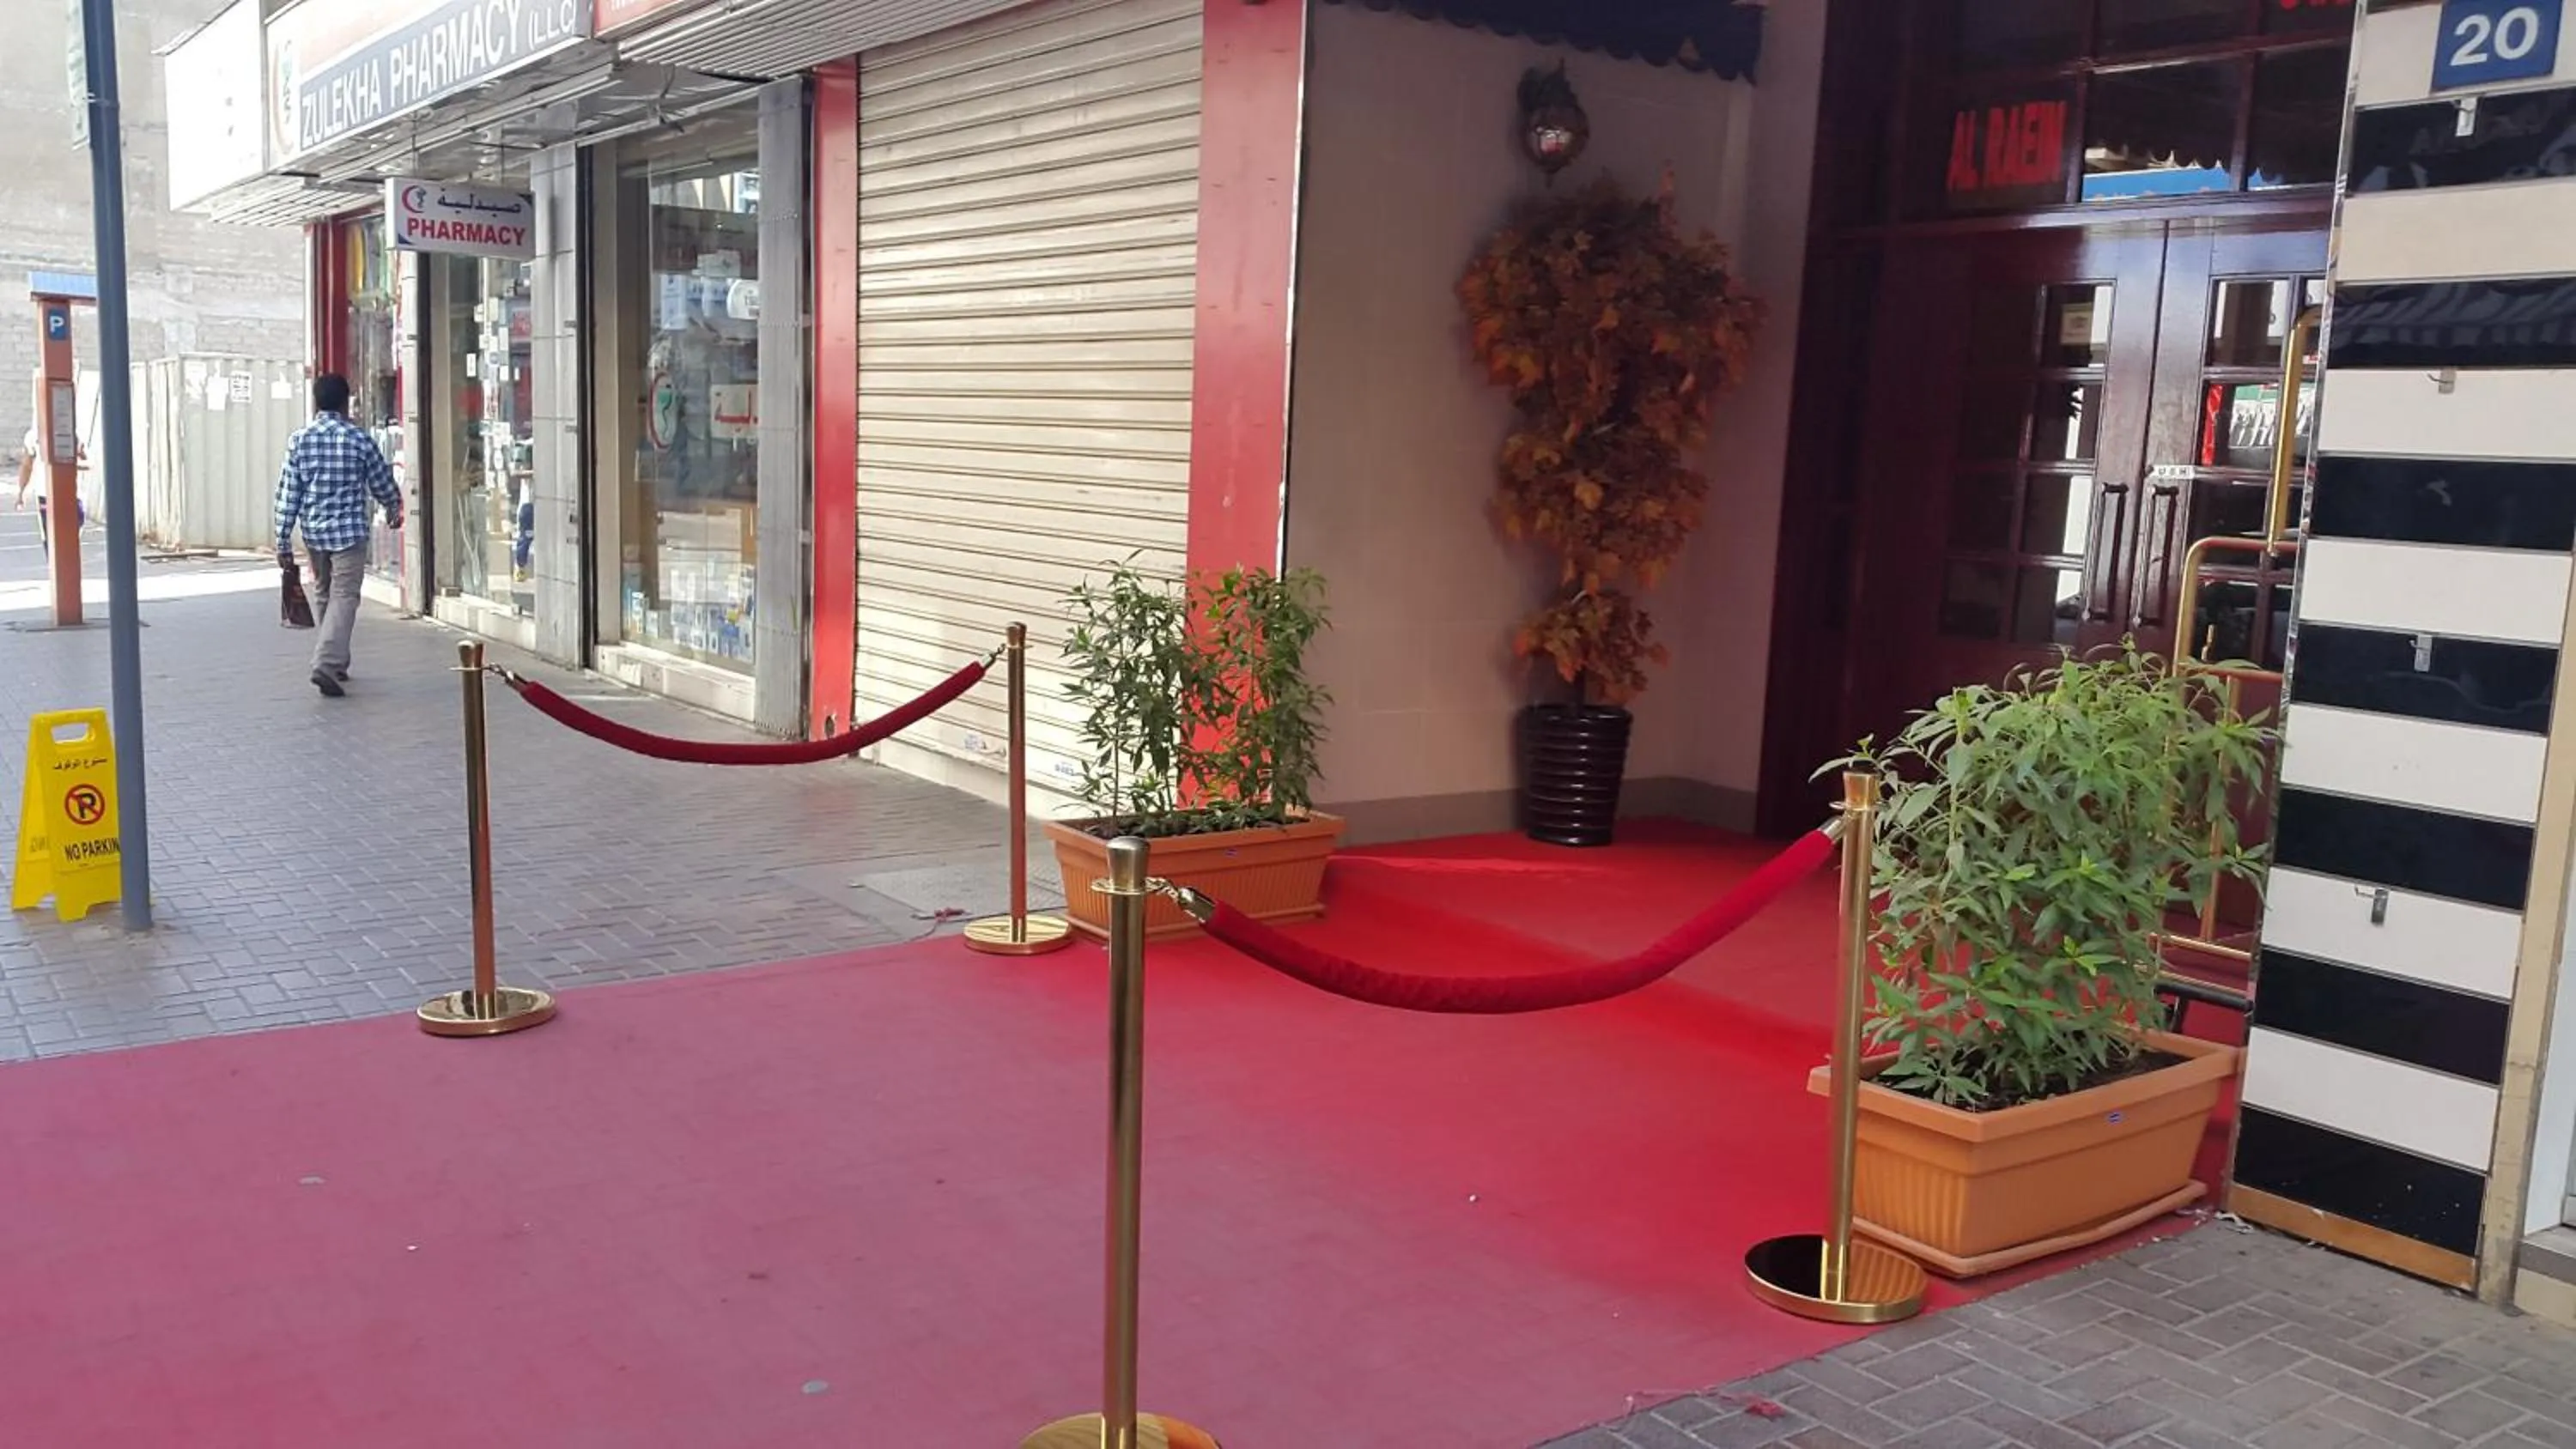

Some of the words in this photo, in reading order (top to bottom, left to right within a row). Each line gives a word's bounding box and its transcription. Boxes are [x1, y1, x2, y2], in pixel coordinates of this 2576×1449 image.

[2450, 7, 2540, 67] 20
[301, 58, 383, 149] ZULEKHA
[390, 0, 520, 107] PHARMACY
[437, 187, 522, 218] صيدلية
[406, 217, 526, 246] PHARMACY
[49, 315, 65, 334] P
[64, 843, 82, 861] NO
[82, 838, 120, 858] PARKIN
